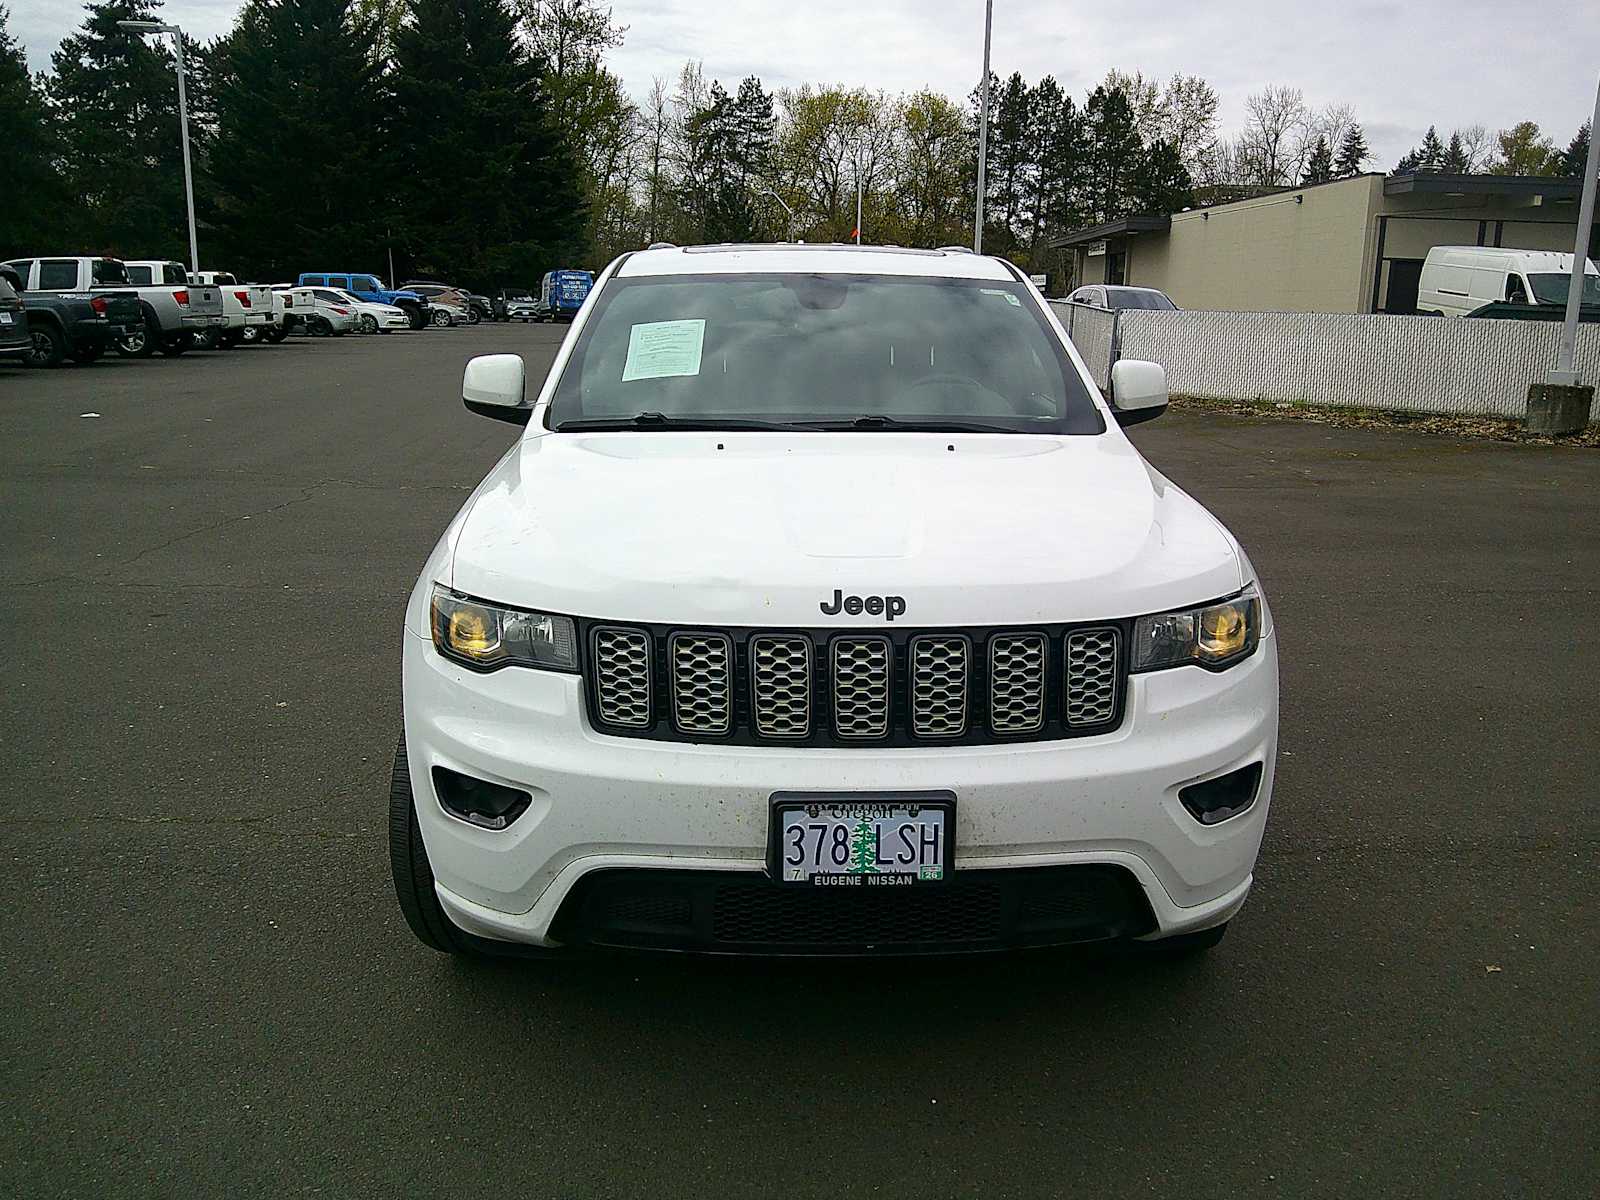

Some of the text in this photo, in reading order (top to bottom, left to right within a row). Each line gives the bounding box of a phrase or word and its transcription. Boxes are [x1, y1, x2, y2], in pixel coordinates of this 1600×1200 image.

[819, 589, 906, 621] Jeep
[786, 823, 939, 866] 378 LSH
[792, 869, 801, 880] 7
[814, 875, 913, 886] EUGENE NISSAN
